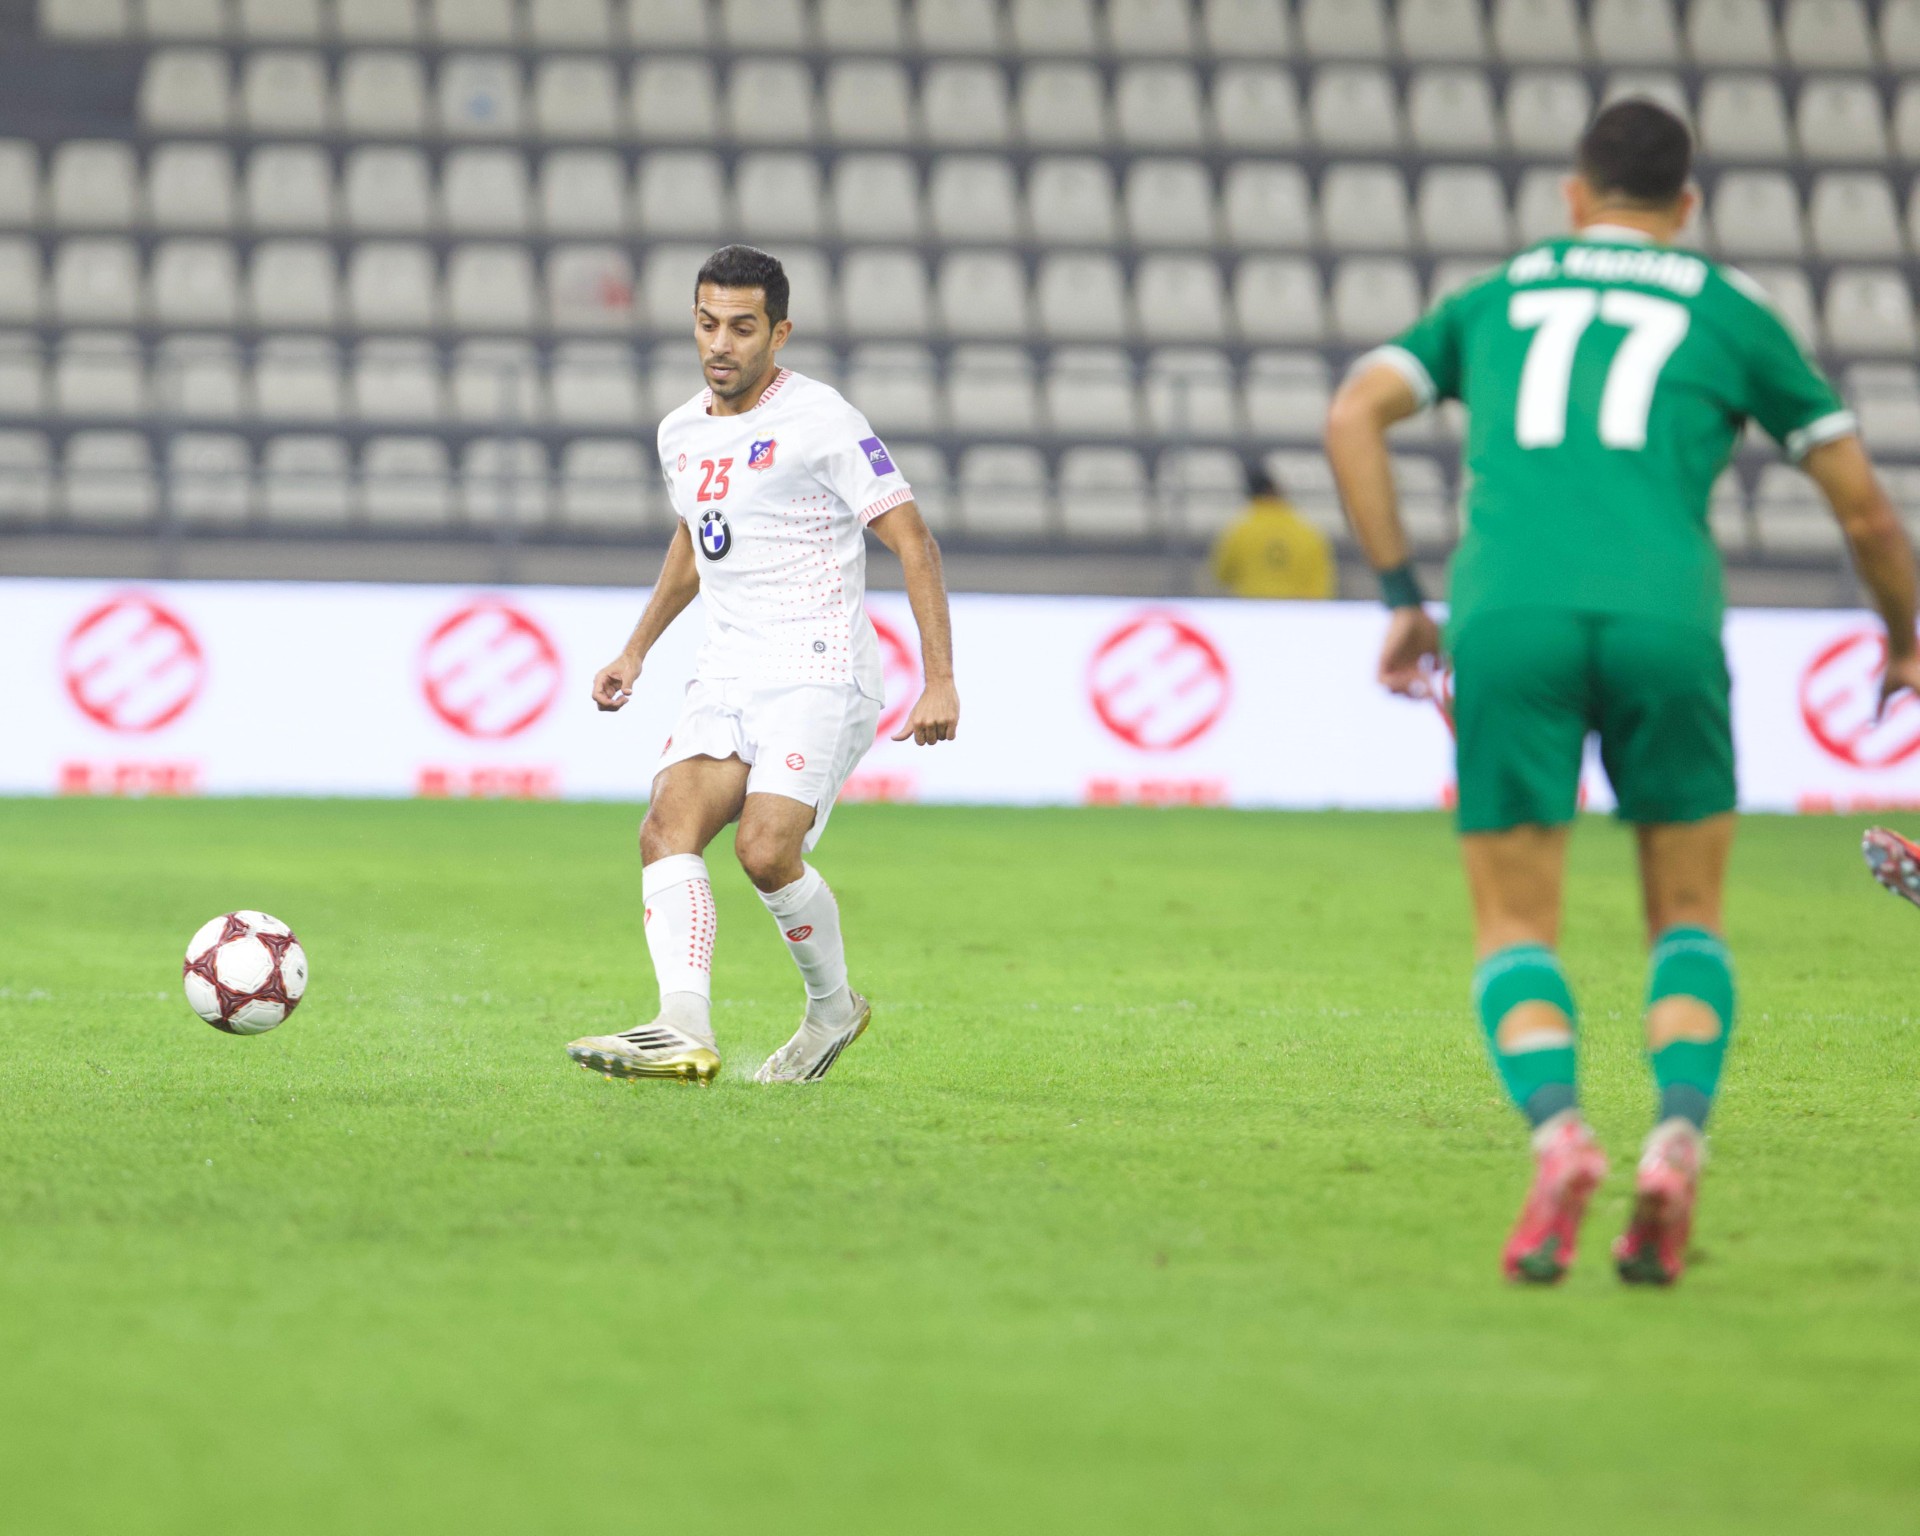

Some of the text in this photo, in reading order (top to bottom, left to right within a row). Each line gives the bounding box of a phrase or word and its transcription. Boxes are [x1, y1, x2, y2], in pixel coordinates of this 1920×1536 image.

[1508, 287, 1690, 451] 77
[697, 457, 734, 502] 23
[700, 511, 727, 529] BMW
